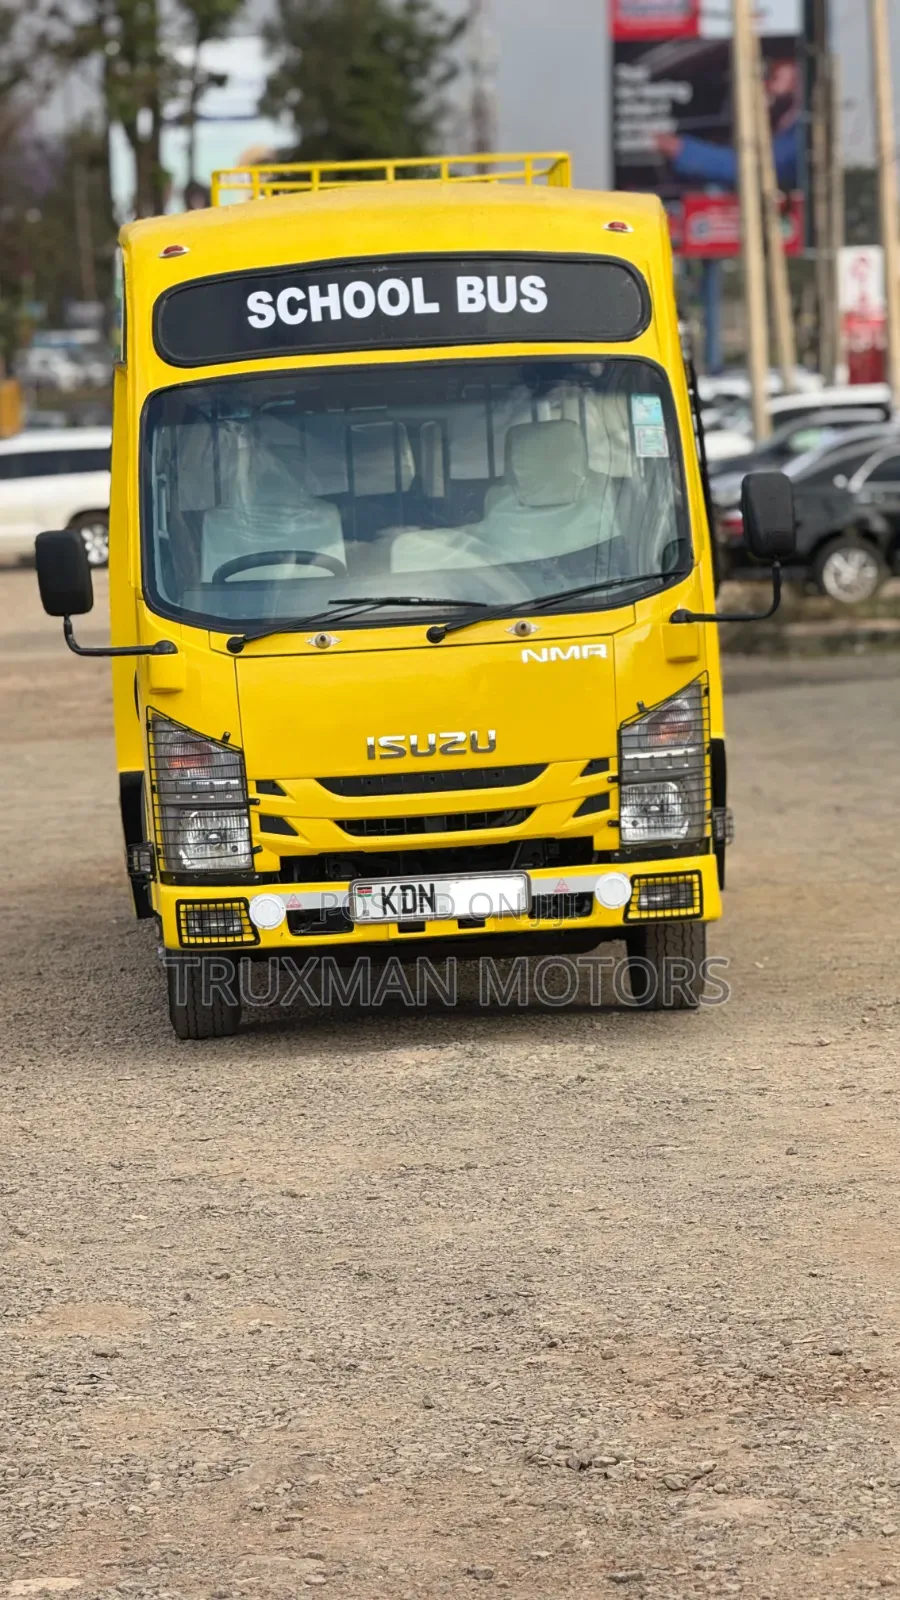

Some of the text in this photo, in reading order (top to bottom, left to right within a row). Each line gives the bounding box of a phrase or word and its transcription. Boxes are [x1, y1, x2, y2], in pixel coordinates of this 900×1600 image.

[247, 275, 548, 329] SCHOOL BUS
[521, 643, 608, 664] NMR
[366, 729, 497, 761] ISUZU
[381, 883, 437, 915] KDN
